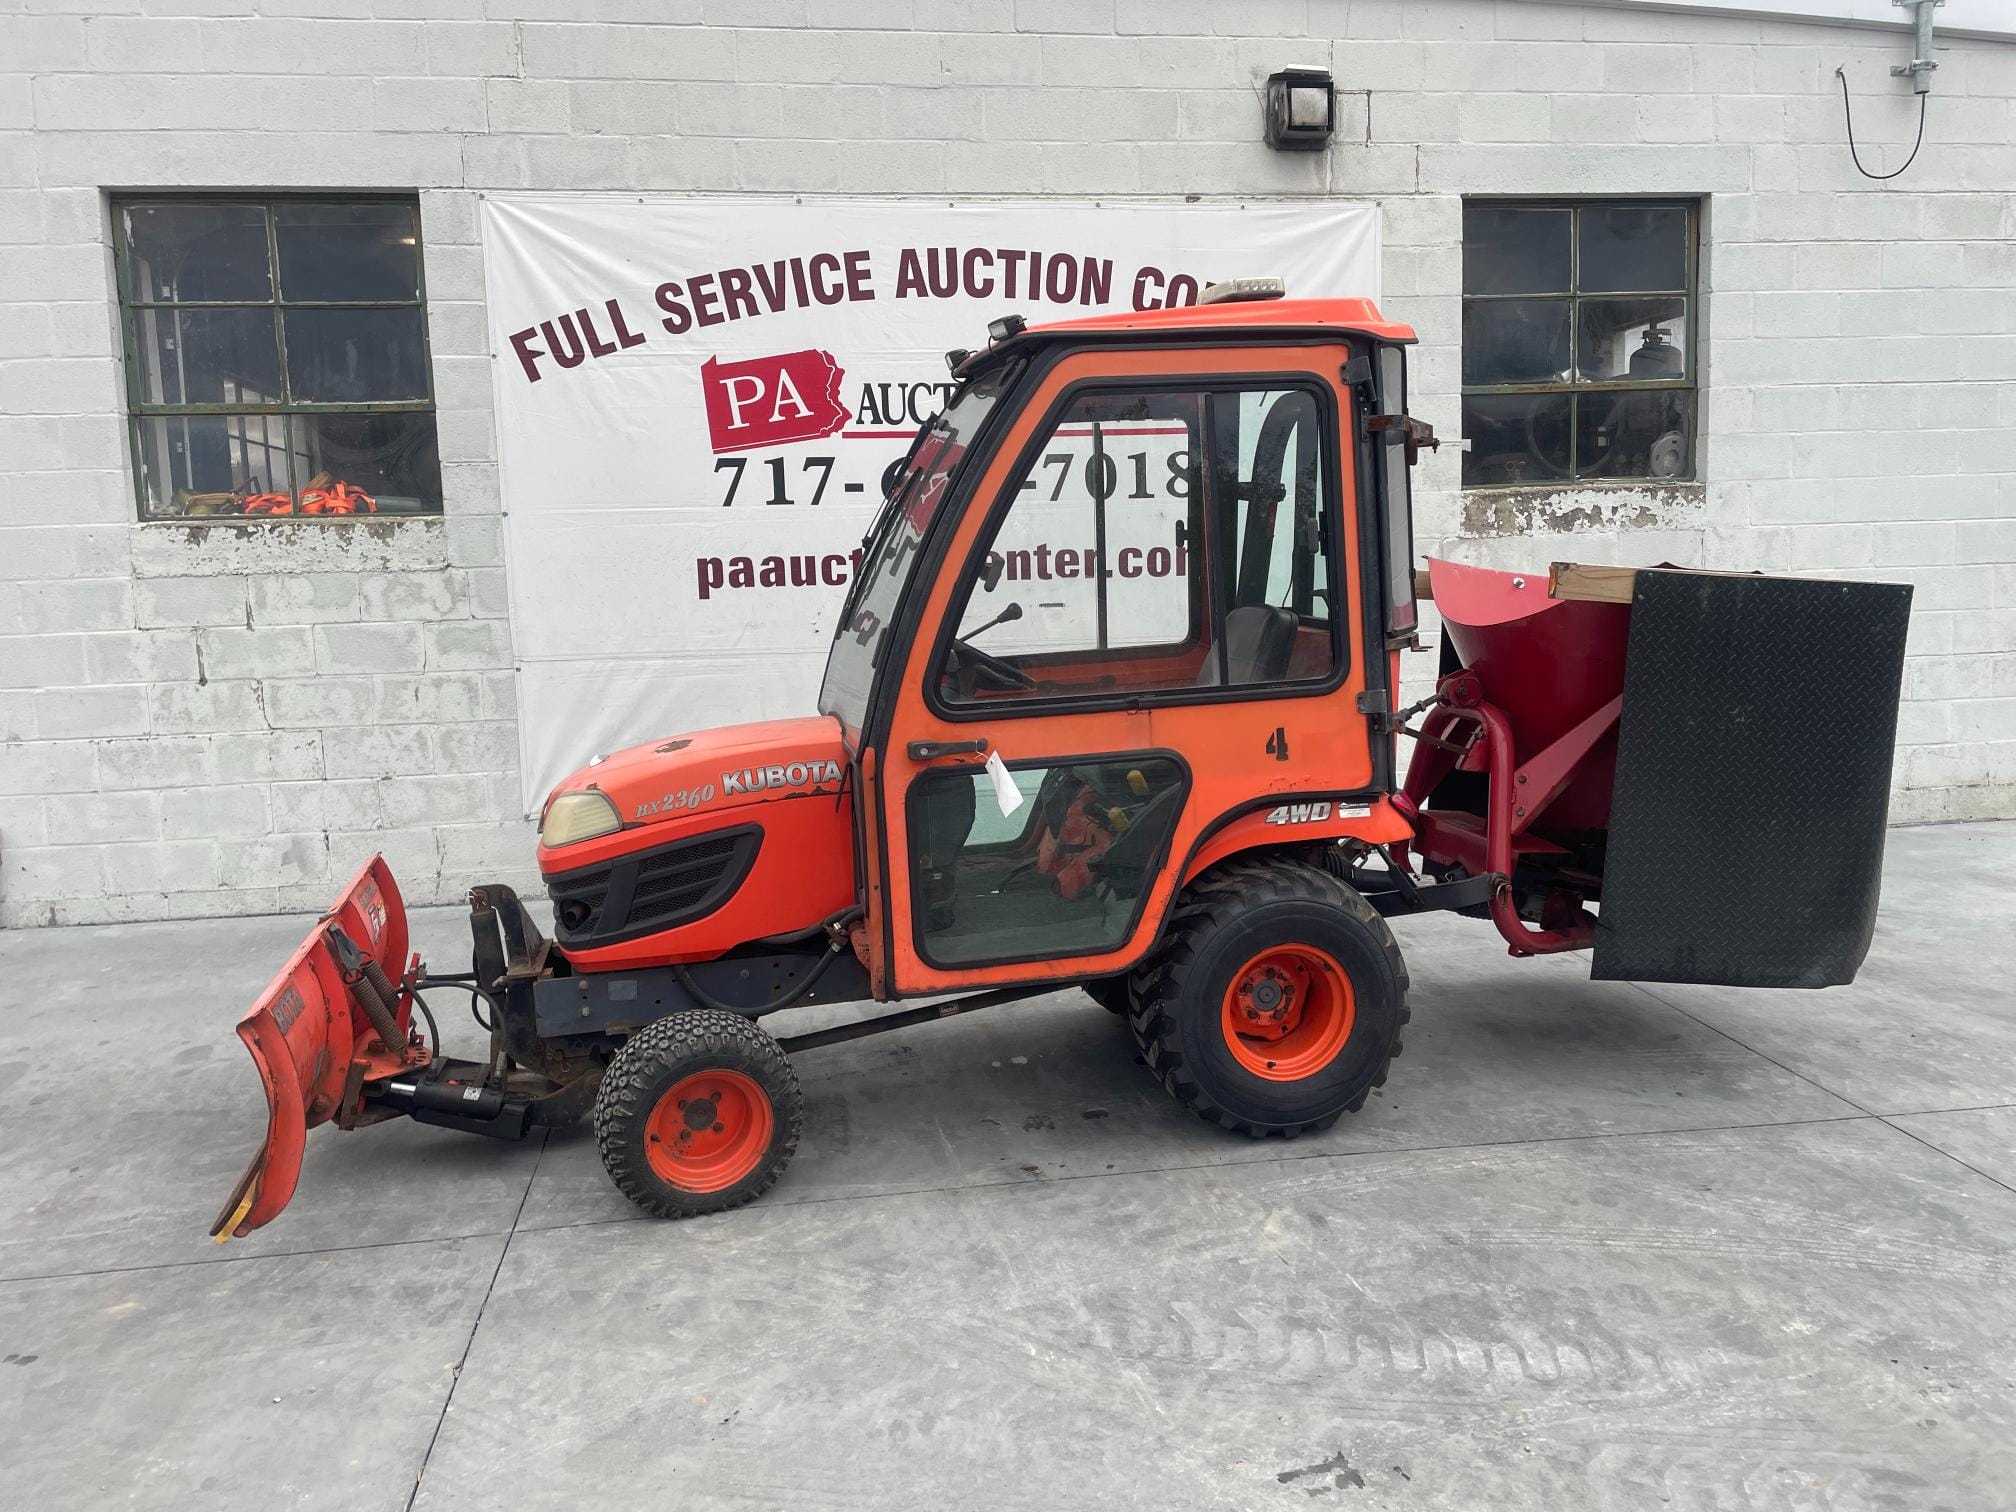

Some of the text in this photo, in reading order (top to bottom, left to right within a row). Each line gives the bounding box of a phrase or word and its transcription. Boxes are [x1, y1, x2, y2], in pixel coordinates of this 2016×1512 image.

[509, 299, 646, 383] FULL
[655, 250, 875, 334] SERVICE
[896, 246, 1113, 305] AUCTION
[719, 368, 814, 430] PA
[1266, 727, 1288, 761] 4
[721, 760, 842, 796] KUBOTA
[1265, 802, 1332, 826] 4WD
